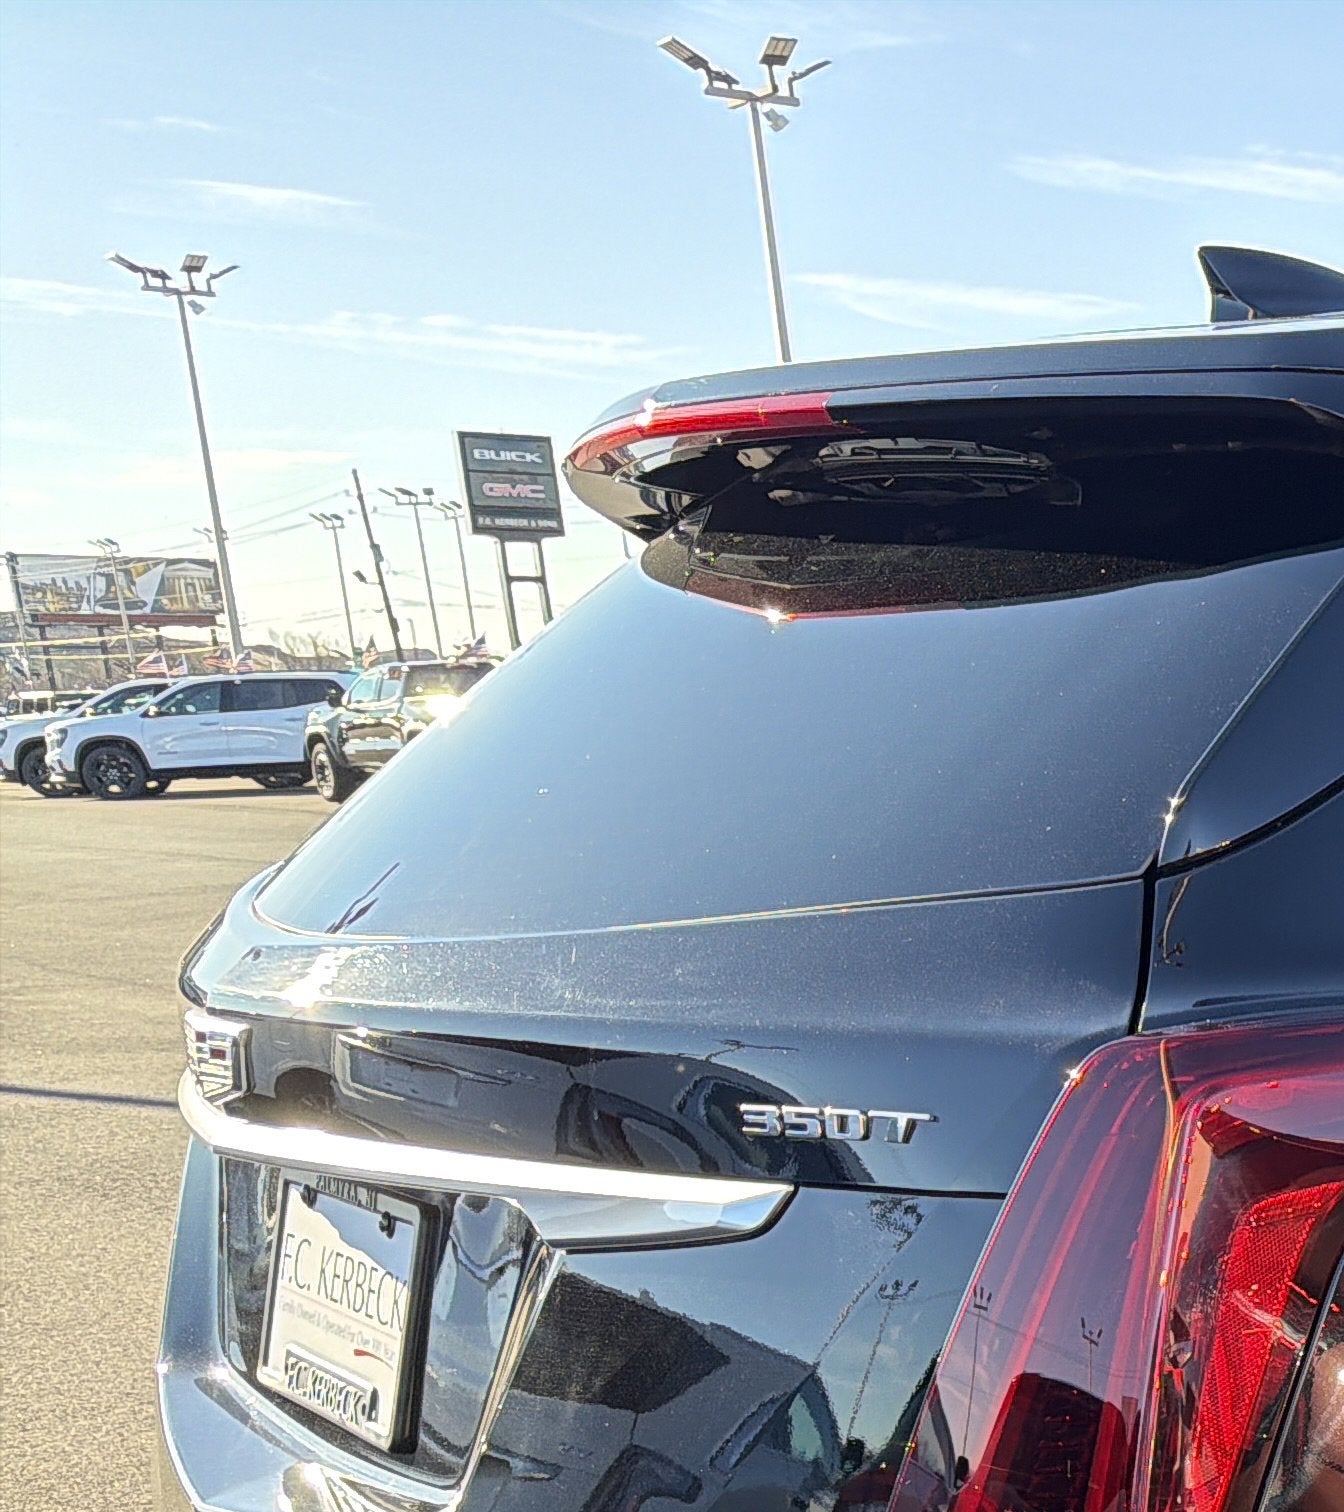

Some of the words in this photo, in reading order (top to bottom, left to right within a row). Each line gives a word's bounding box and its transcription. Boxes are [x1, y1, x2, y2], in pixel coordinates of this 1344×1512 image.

[473, 448, 544, 464] BUICK
[482, 482, 547, 499] GMC
[738, 1102, 938, 1144] 350T
[281, 1233, 311, 1291] F.C.
[317, 1245, 408, 1332] KERBECK
[309, 1366, 364, 1426] KERBECK
